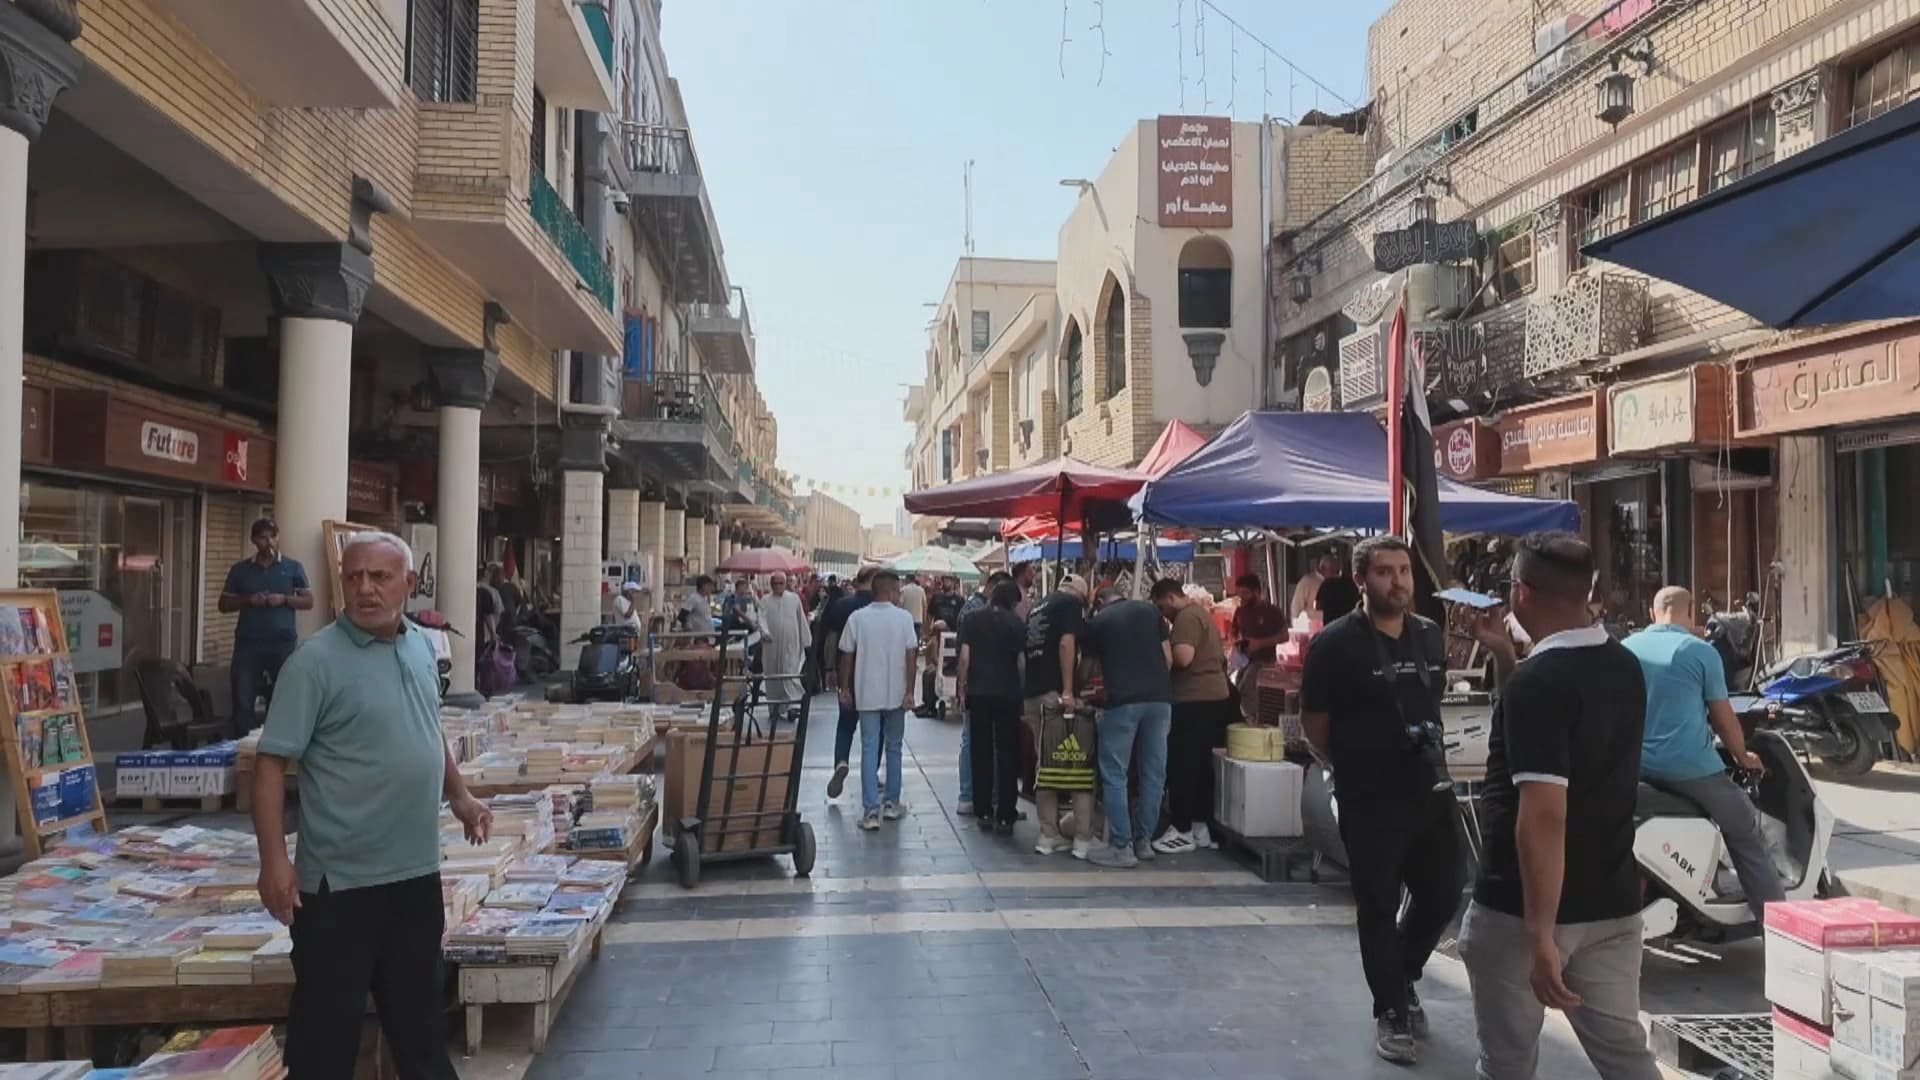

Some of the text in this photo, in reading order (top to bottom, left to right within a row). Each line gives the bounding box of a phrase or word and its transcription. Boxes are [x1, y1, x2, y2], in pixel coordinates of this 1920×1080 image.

[1180, 122, 1208, 135] مجمع
[1785, 341, 1900, 413] المشرق
[146, 427, 195, 460] Future
[1670, 851, 1696, 878] ABK
